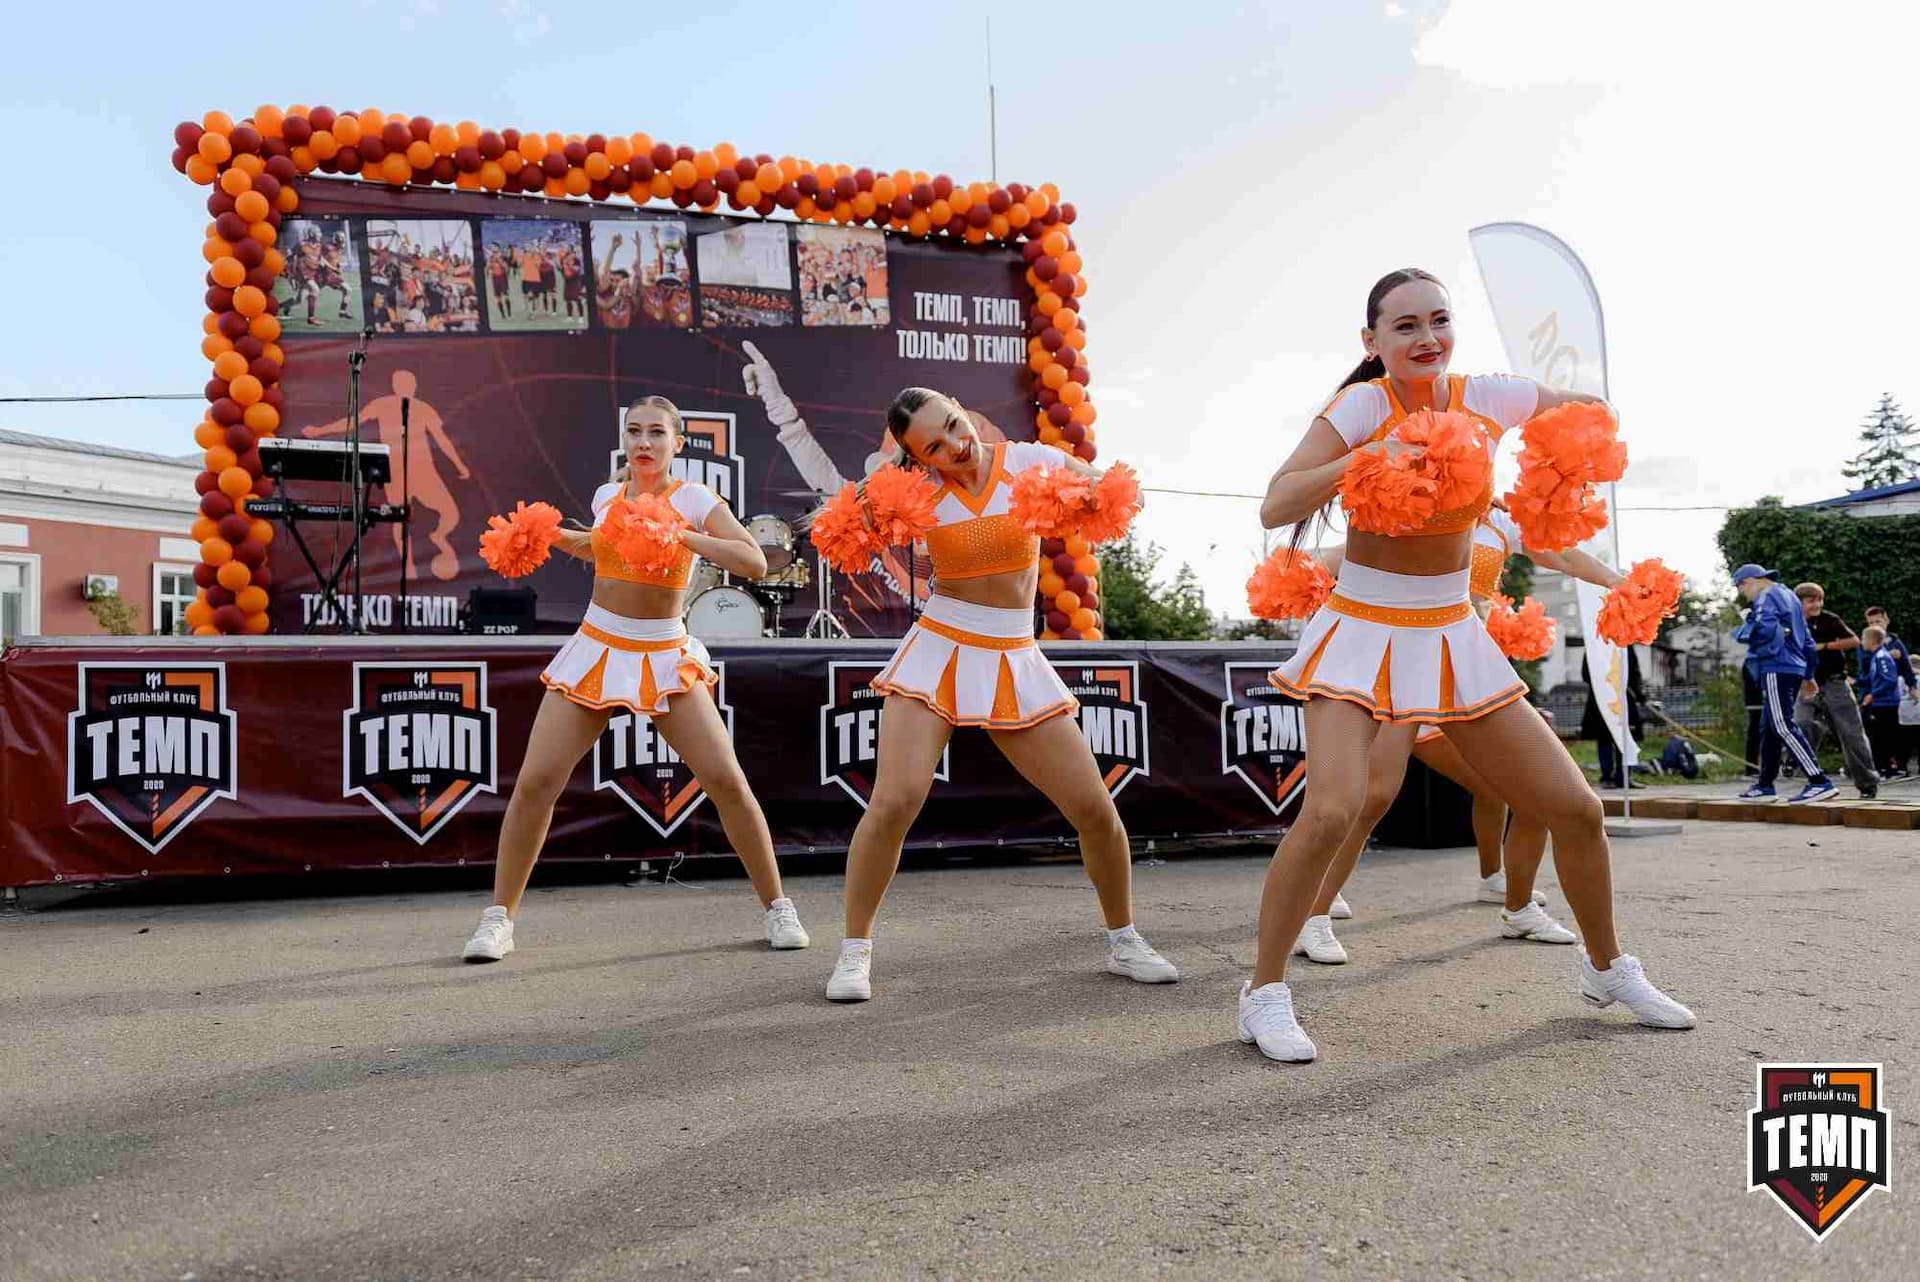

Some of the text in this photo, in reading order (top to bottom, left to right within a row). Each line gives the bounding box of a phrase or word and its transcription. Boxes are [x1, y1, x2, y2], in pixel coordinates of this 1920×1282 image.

[914, 292, 1026, 330] ТЕМП, ТЕМП,
[896, 330, 1027, 364] ТОЛЬКО ТЕМП!
[110, 691, 197, 705] ФУТБОЛЬНЫЙ КЛУБ
[381, 689, 460, 703] ФУТБОЛЬНЫЙ КЛУБ
[87, 716, 220, 781] ТЕМП
[360, 713, 482, 776] ТЕМП
[835, 709, 883, 765] ТЕ
[1082, 706, 1137, 759] МП
